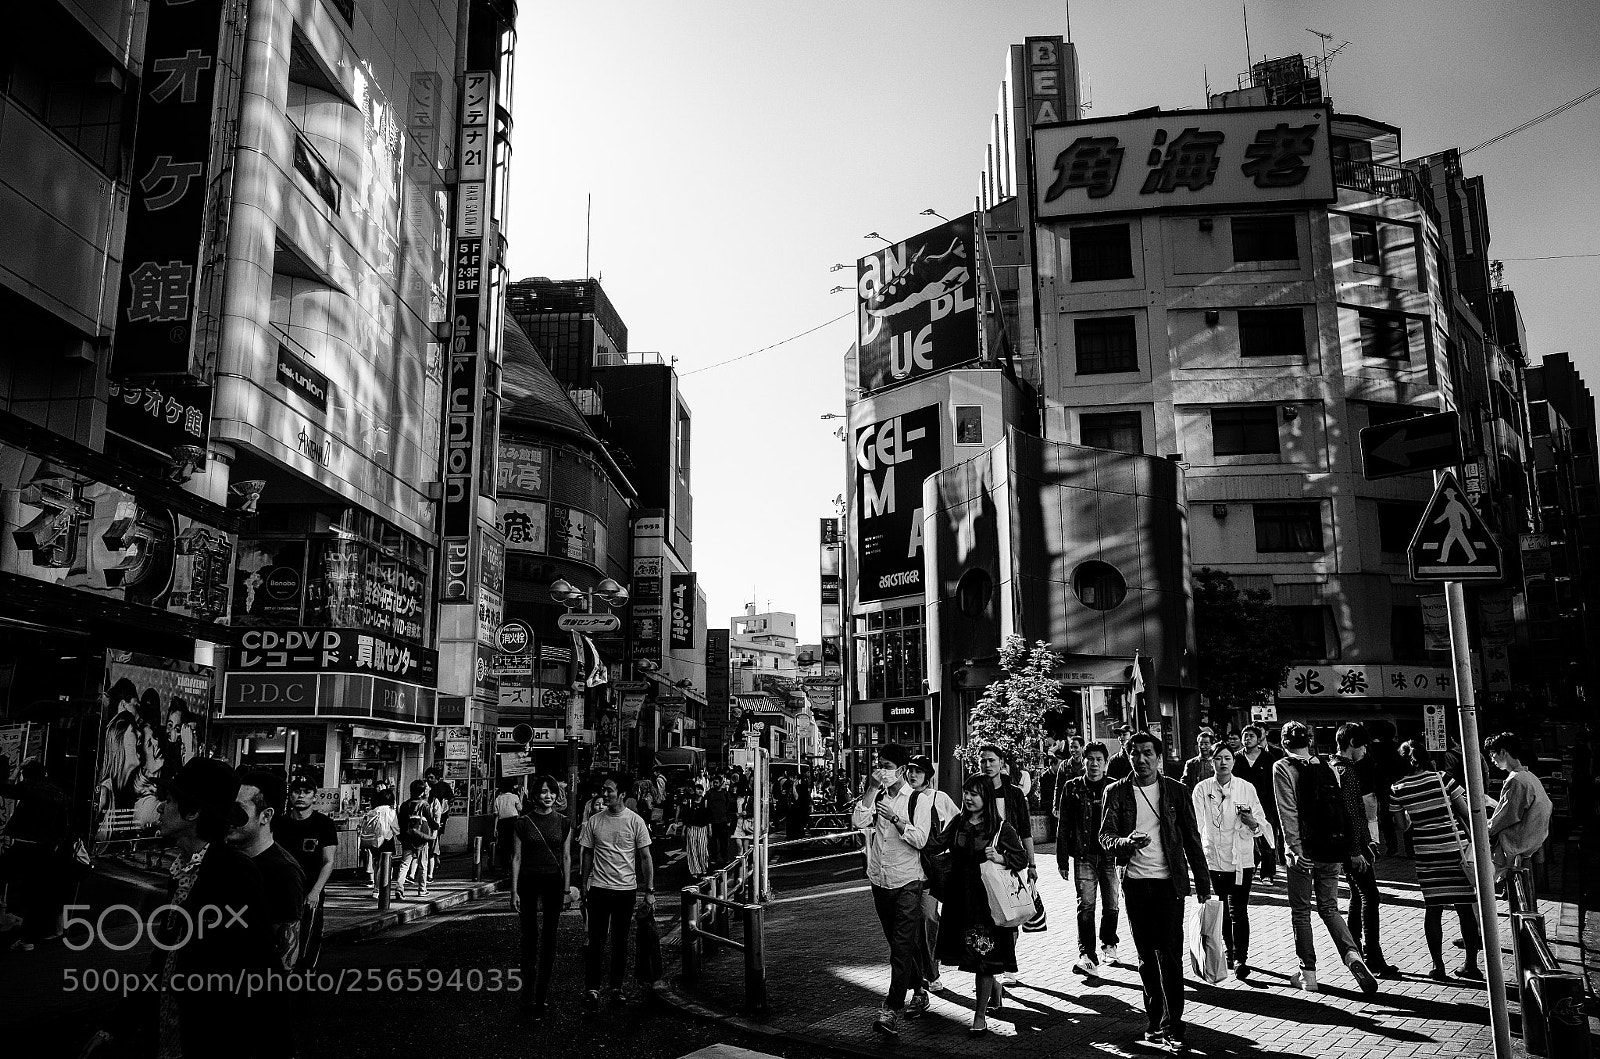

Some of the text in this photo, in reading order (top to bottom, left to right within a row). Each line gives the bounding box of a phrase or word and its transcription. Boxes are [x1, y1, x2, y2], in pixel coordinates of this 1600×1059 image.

[1032, 41, 1060, 124] BEA
[467, 77, 484, 144] アンテナ
[128, 0, 211, 322] オケ館
[465, 150, 482, 166] 21
[1045, 123, 1320, 203] 角海老
[466, 185, 479, 202] HAIR
[465, 204, 478, 226] SALON
[457, 279, 478, 290] B1F
[278, 362, 324, 400] disk union
[447, 314, 472, 504] disk union
[856, 415, 926, 471] GEL-
[502, 632, 525, 645] 消火栓
[240, 650, 341, 668] レコード
[355, 634, 418, 675] 買取センター
[239, 683, 304, 703] P.D.C
[1295, 669, 1368, 694] 兆楽
[383, 689, 405, 709] P.D.C
[890, 707, 915, 715] atmos
